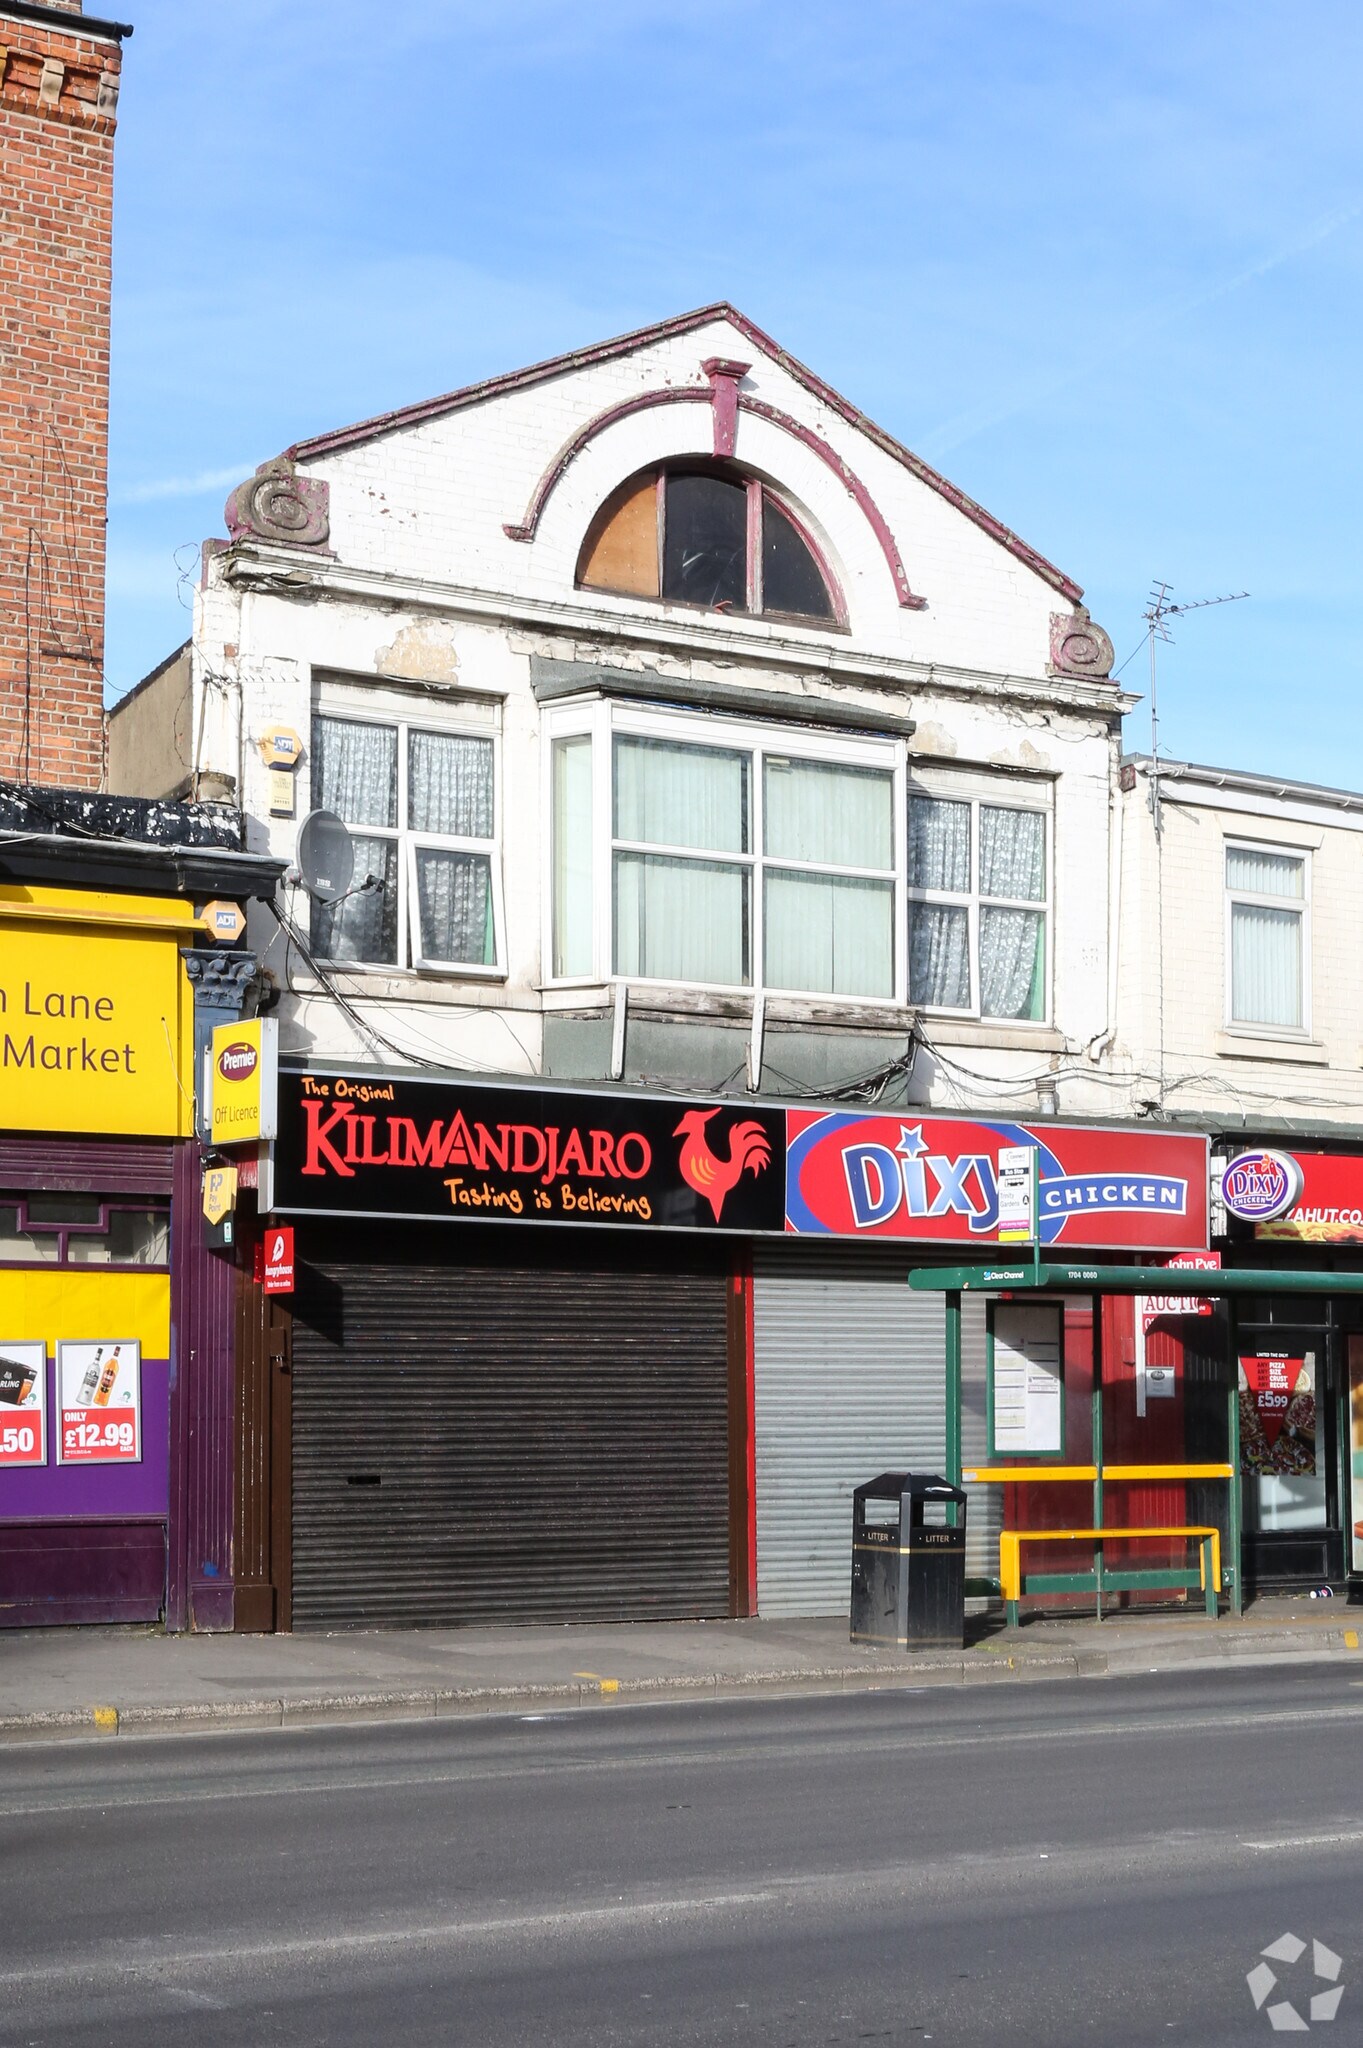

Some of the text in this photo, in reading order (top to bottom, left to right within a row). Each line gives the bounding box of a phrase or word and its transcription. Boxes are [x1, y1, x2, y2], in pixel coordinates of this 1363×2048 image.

[216, 914, 236, 926] ADT
[25, 981, 114, 1021] Lane
[4, 1033, 136, 1074] Market
[223, 1051, 257, 1070] Premier
[301, 1077, 395, 1102] The Original
[215, 1106, 258, 1124] Off Licence
[301, 1099, 652, 1185] KILIMANDJARO
[841, 1124, 999, 1233] Dixy
[1232, 1166, 1281, 1200] Dixy
[444, 1178, 652, 1219] Tasting is Believing
[1045, 1185, 1177, 1207] CHICKEN
[1233, 1197, 1266, 1206] CHICKEN
[1166, 1258, 1217, 1271] John Pye
[1004, 1271, 1024, 1279] Channel
[0, 1380, 20, 1388] RLING
[1258, 1391, 1288, 1408] £5.99
[64, 1412, 87, 1422] ONLY
[65, 1423, 134, 1447] £12.99
[868, 1532, 889, 1541] LITTER
